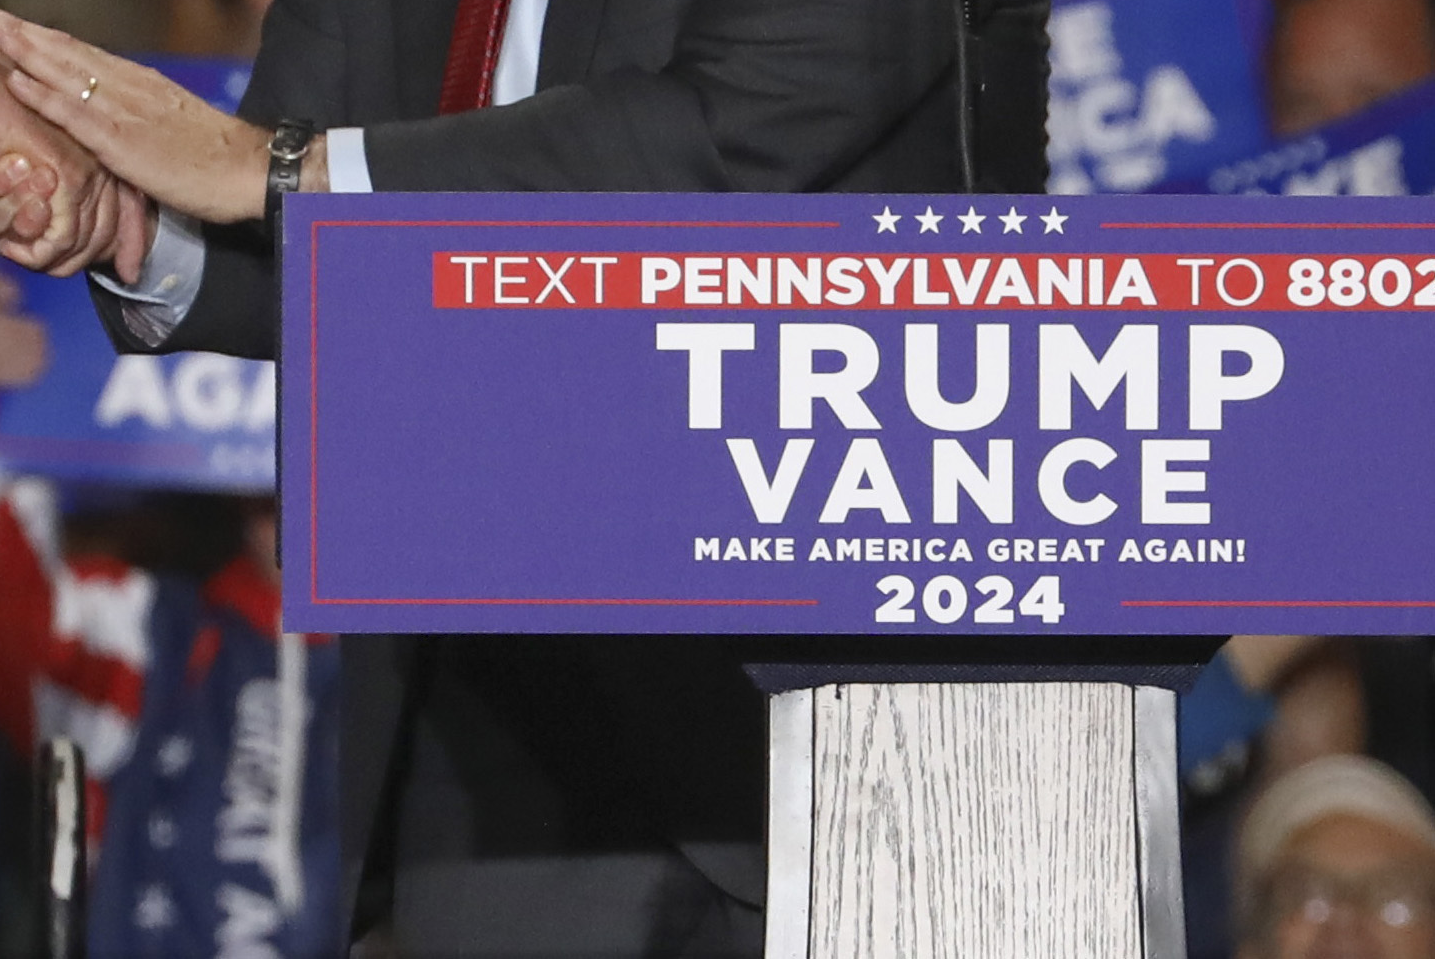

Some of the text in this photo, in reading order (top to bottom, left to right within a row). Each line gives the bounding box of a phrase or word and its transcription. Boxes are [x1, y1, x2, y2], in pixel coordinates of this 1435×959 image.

[450, 255, 618, 304] TEXT
[641, 256, 1158, 306] PENNSYLVANIA
[1175, 257, 1264, 307] TO
[655, 321, 1285, 432] TRUMP
[725, 437, 1211, 526] VANCE
[693, 536, 1246, 563] MAKE AMERICA GREAT AGAIN!
[874, 573, 1065, 624] 2024
